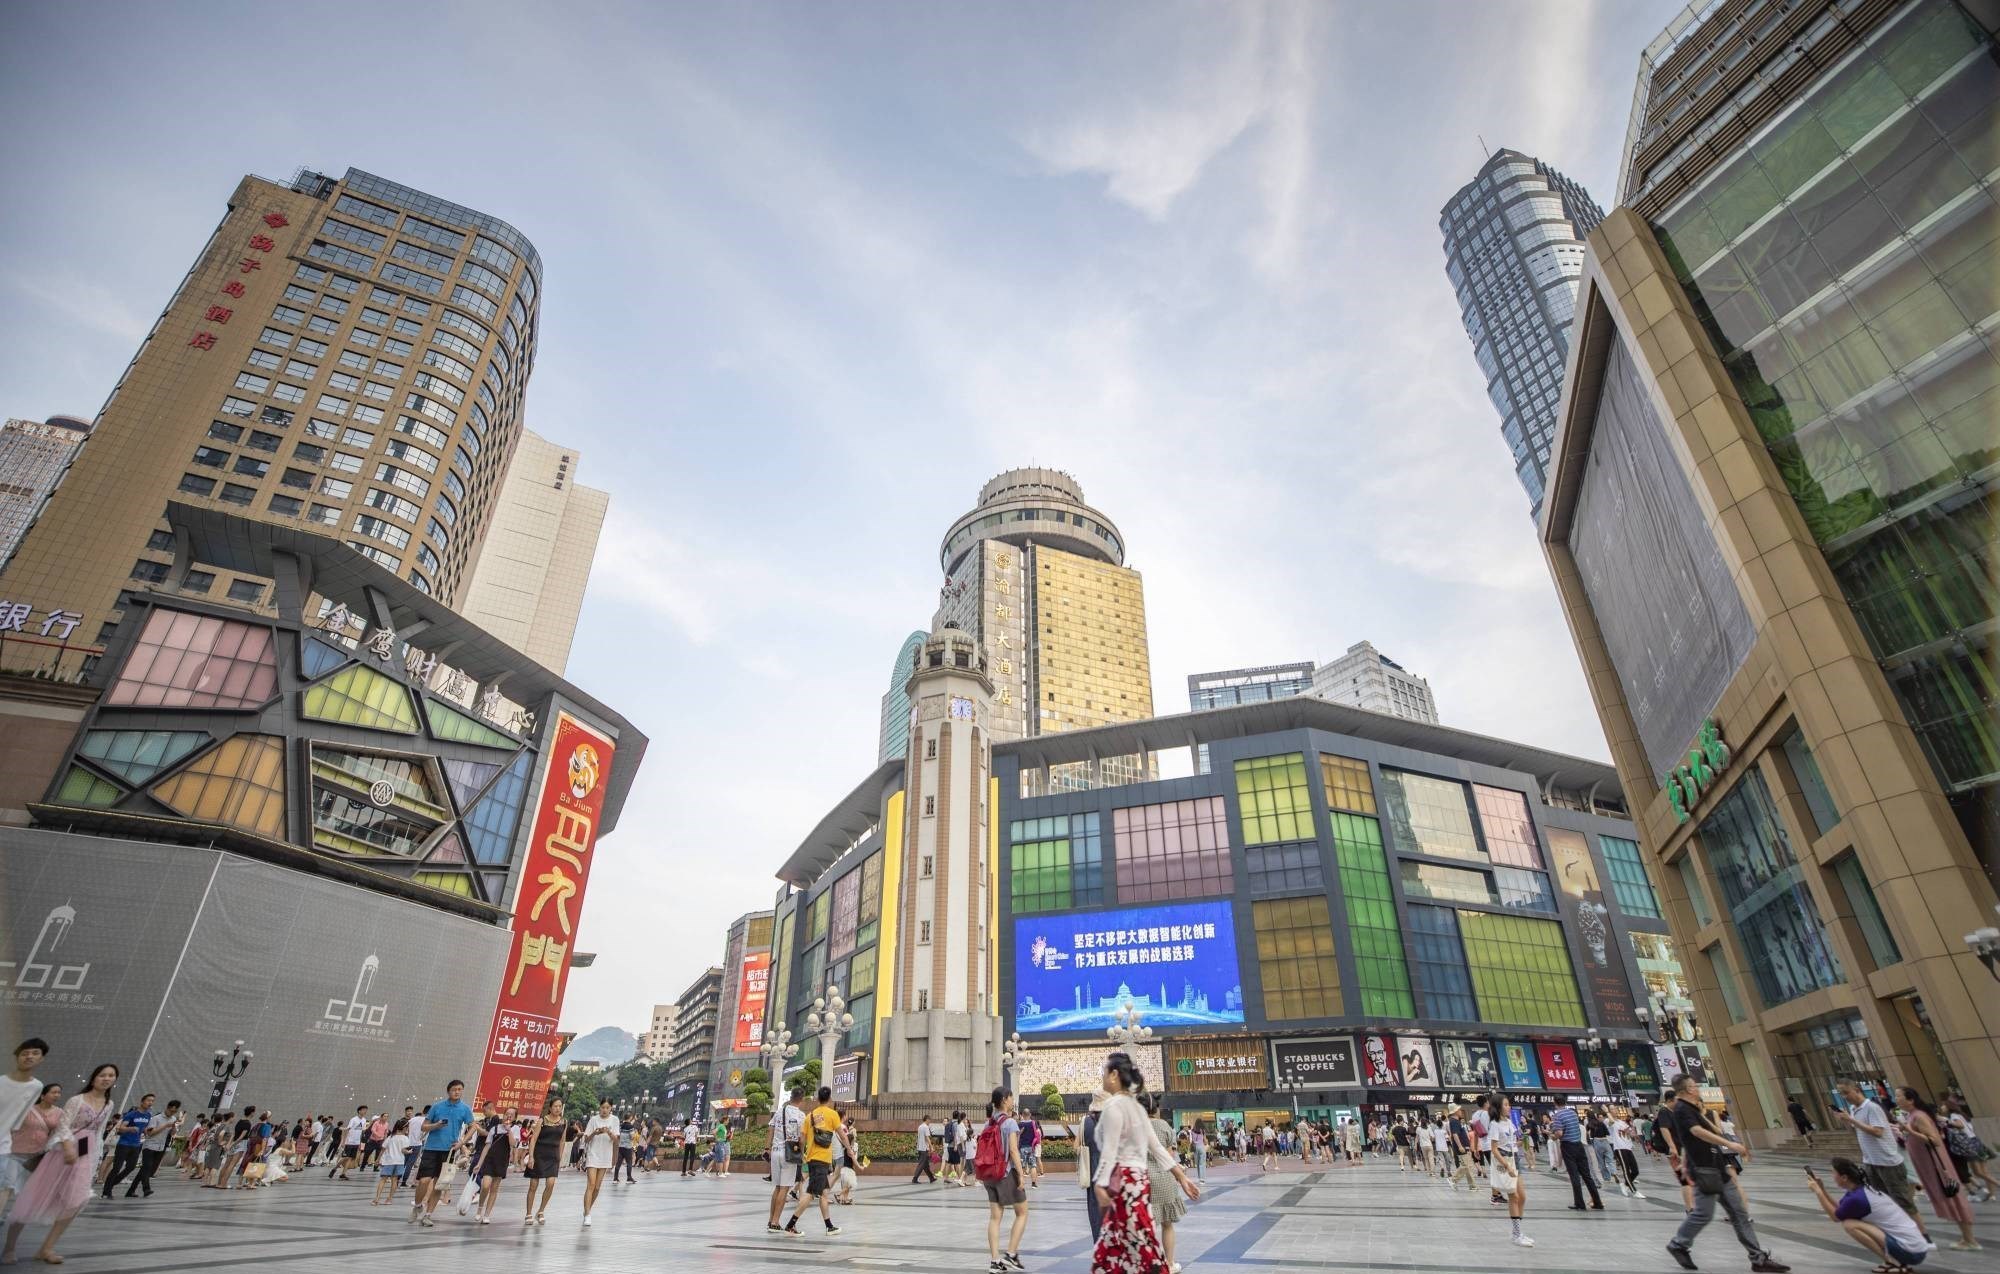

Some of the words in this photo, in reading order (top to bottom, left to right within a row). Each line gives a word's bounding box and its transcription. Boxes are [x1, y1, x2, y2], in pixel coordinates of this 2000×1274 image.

[187, 232, 275, 351] 扬子岛酒店
[0, 600, 84, 640] 银行
[994, 577, 1013, 705] 渝都大酒店
[320, 601, 538, 735] 金鹰财富中心
[1074, 923, 1215, 949] 坚定不移把大数据智能化创新
[1074, 945, 1195, 969] 作为重庆发展的战略选择
[1196, 1056, 1257, 1068] 中国农业银行
[1284, 1053, 1345, 1063] STARBUCKS
[1296, 1062, 1335, 1071] COFFEE
[1663, 1058, 1677, 1067] 5G
[1687, 1056, 1701, 1067] 5G
[1609, 1075, 1619, 1083] 5G
